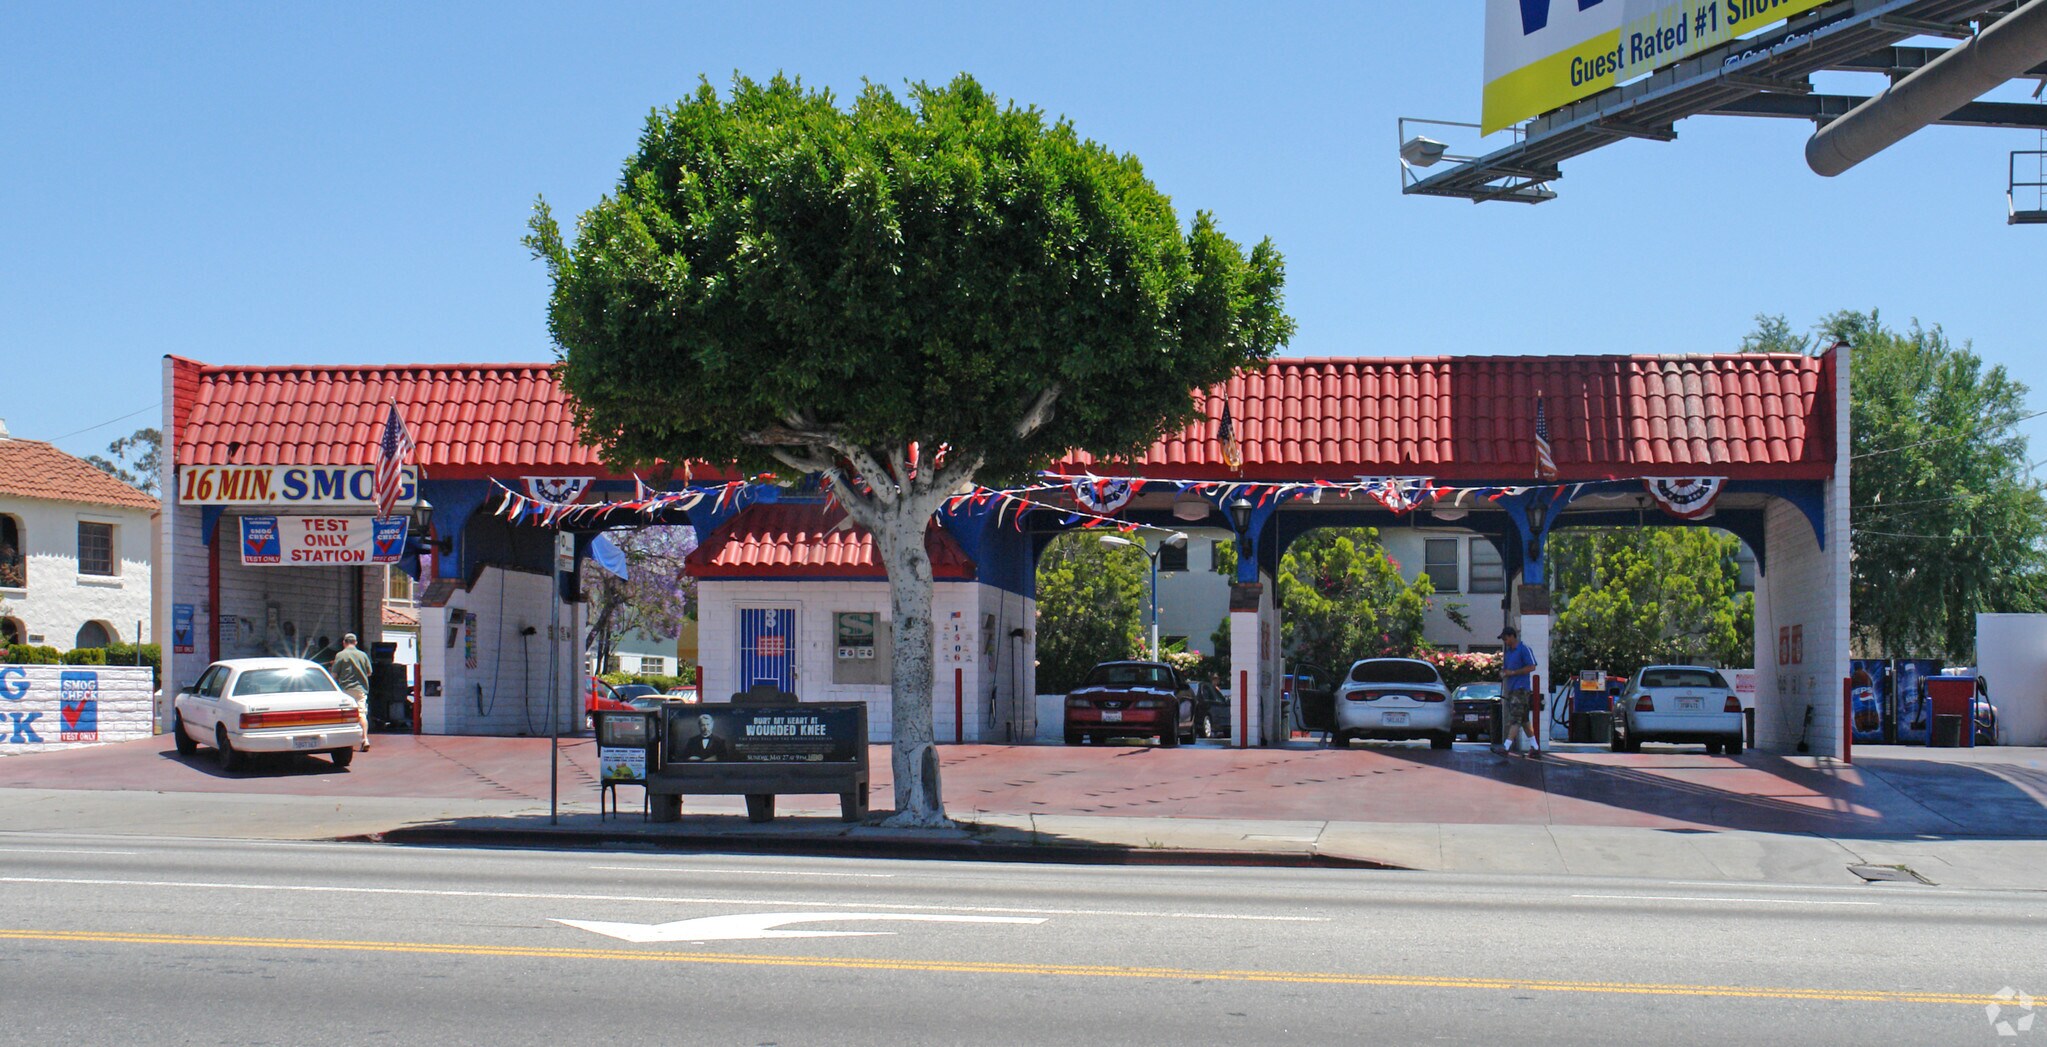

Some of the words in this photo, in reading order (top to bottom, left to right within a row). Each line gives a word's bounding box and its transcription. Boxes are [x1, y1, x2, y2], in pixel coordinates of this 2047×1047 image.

[1570, 41, 1624, 87] Guest
[1631, 13, 1687, 64] Rated
[1695, 1, 1717, 39] #1
[183, 469, 213, 500] 16
[217, 469, 276, 501] MIN.
[282, 469, 416, 501] SMOG
[302, 518, 349, 531] TEST
[304, 534, 348, 547] ONLY
[291, 549, 365, 562] STATION
[0, 666, 31, 700] G
[63, 680, 97, 690] SMOG
[61, 691, 98, 700] CHECK
[0, 712, 44, 743] K
[753, 717, 771, 725] BURY
[773, 717, 784, 725] MY
[787, 717, 808, 725] HEART
[62, 732, 78, 740] TEST
[80, 732, 97, 740] ONLY
[746, 725, 796, 736] WOUNDED
[800, 724, 826, 736] KNEE
